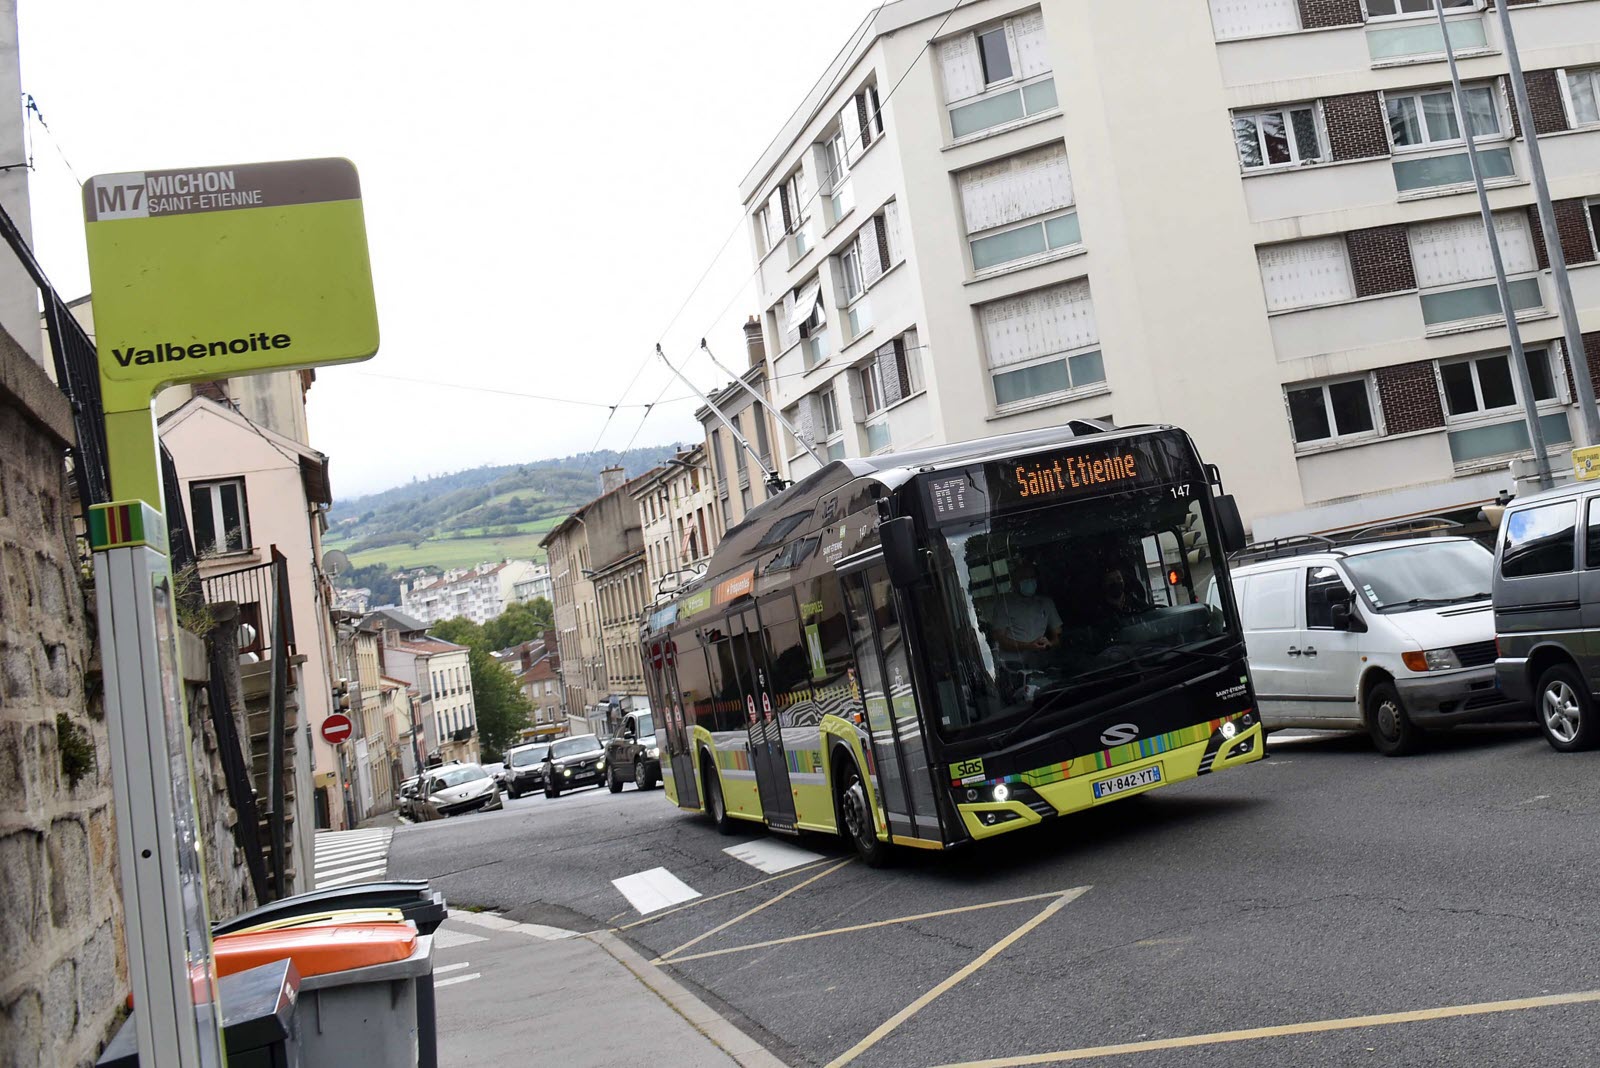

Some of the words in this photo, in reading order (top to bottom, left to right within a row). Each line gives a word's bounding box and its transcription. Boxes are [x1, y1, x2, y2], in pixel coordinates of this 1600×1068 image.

[97, 184, 146, 213] M7
[147, 171, 236, 196] MICHON
[148, 190, 264, 213] SAINT-ETIENNE
[112, 333, 292, 367] Valbenoite
[1015, 460, 1066, 497] Saint
[1066, 454, 1136, 488] Etienne
[1170, 484, 1190, 499] 147
[957, 760, 982, 777] stas
